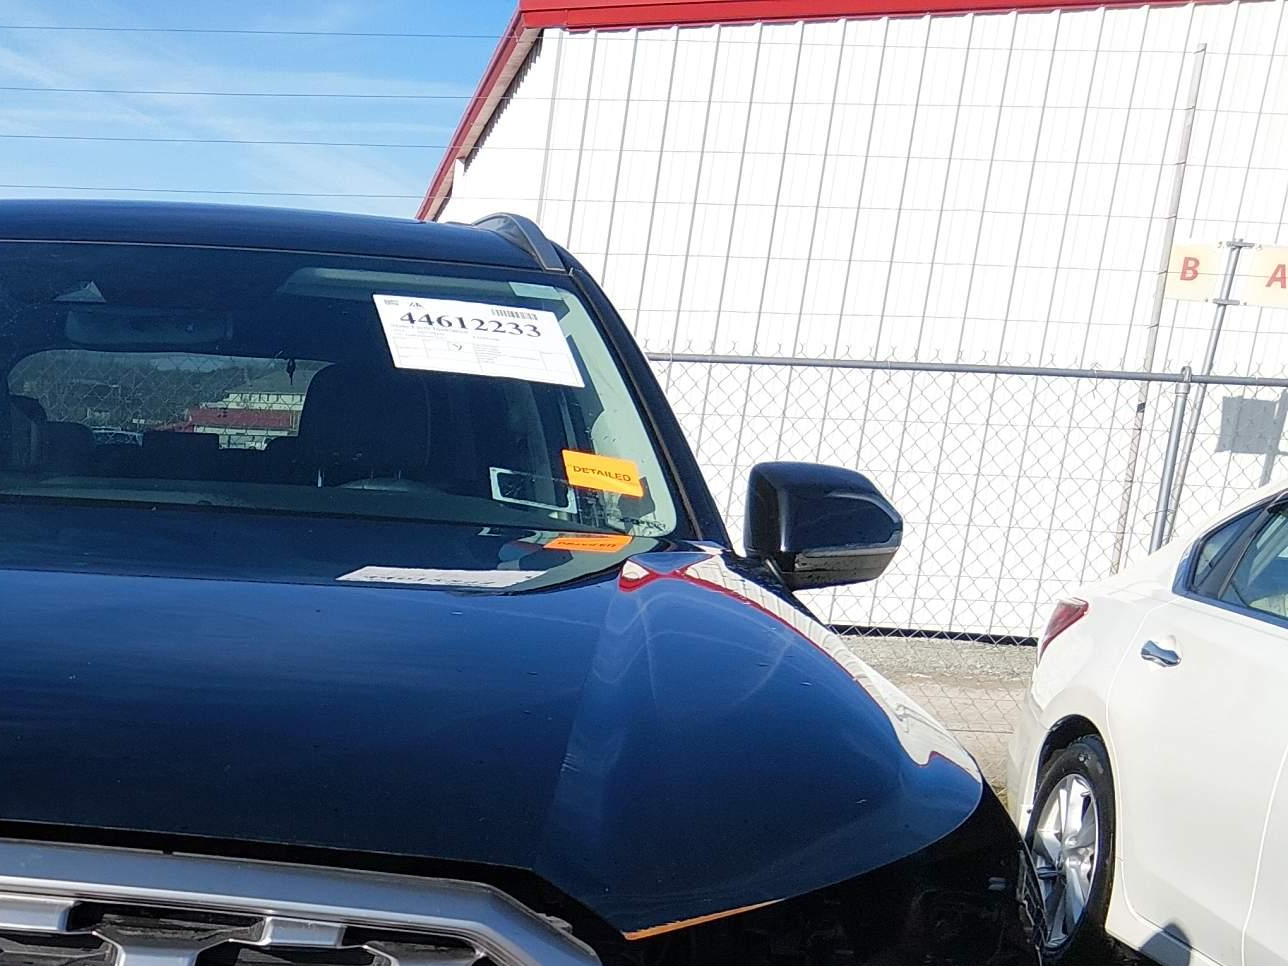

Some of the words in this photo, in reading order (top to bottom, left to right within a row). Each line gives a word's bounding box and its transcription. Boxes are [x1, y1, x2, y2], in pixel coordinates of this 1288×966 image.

[1179, 256, 1200, 281] B
[1265, 264, 1287, 289] A
[399, 311, 542, 338] 44612233
[572, 465, 632, 482] DETAILED
